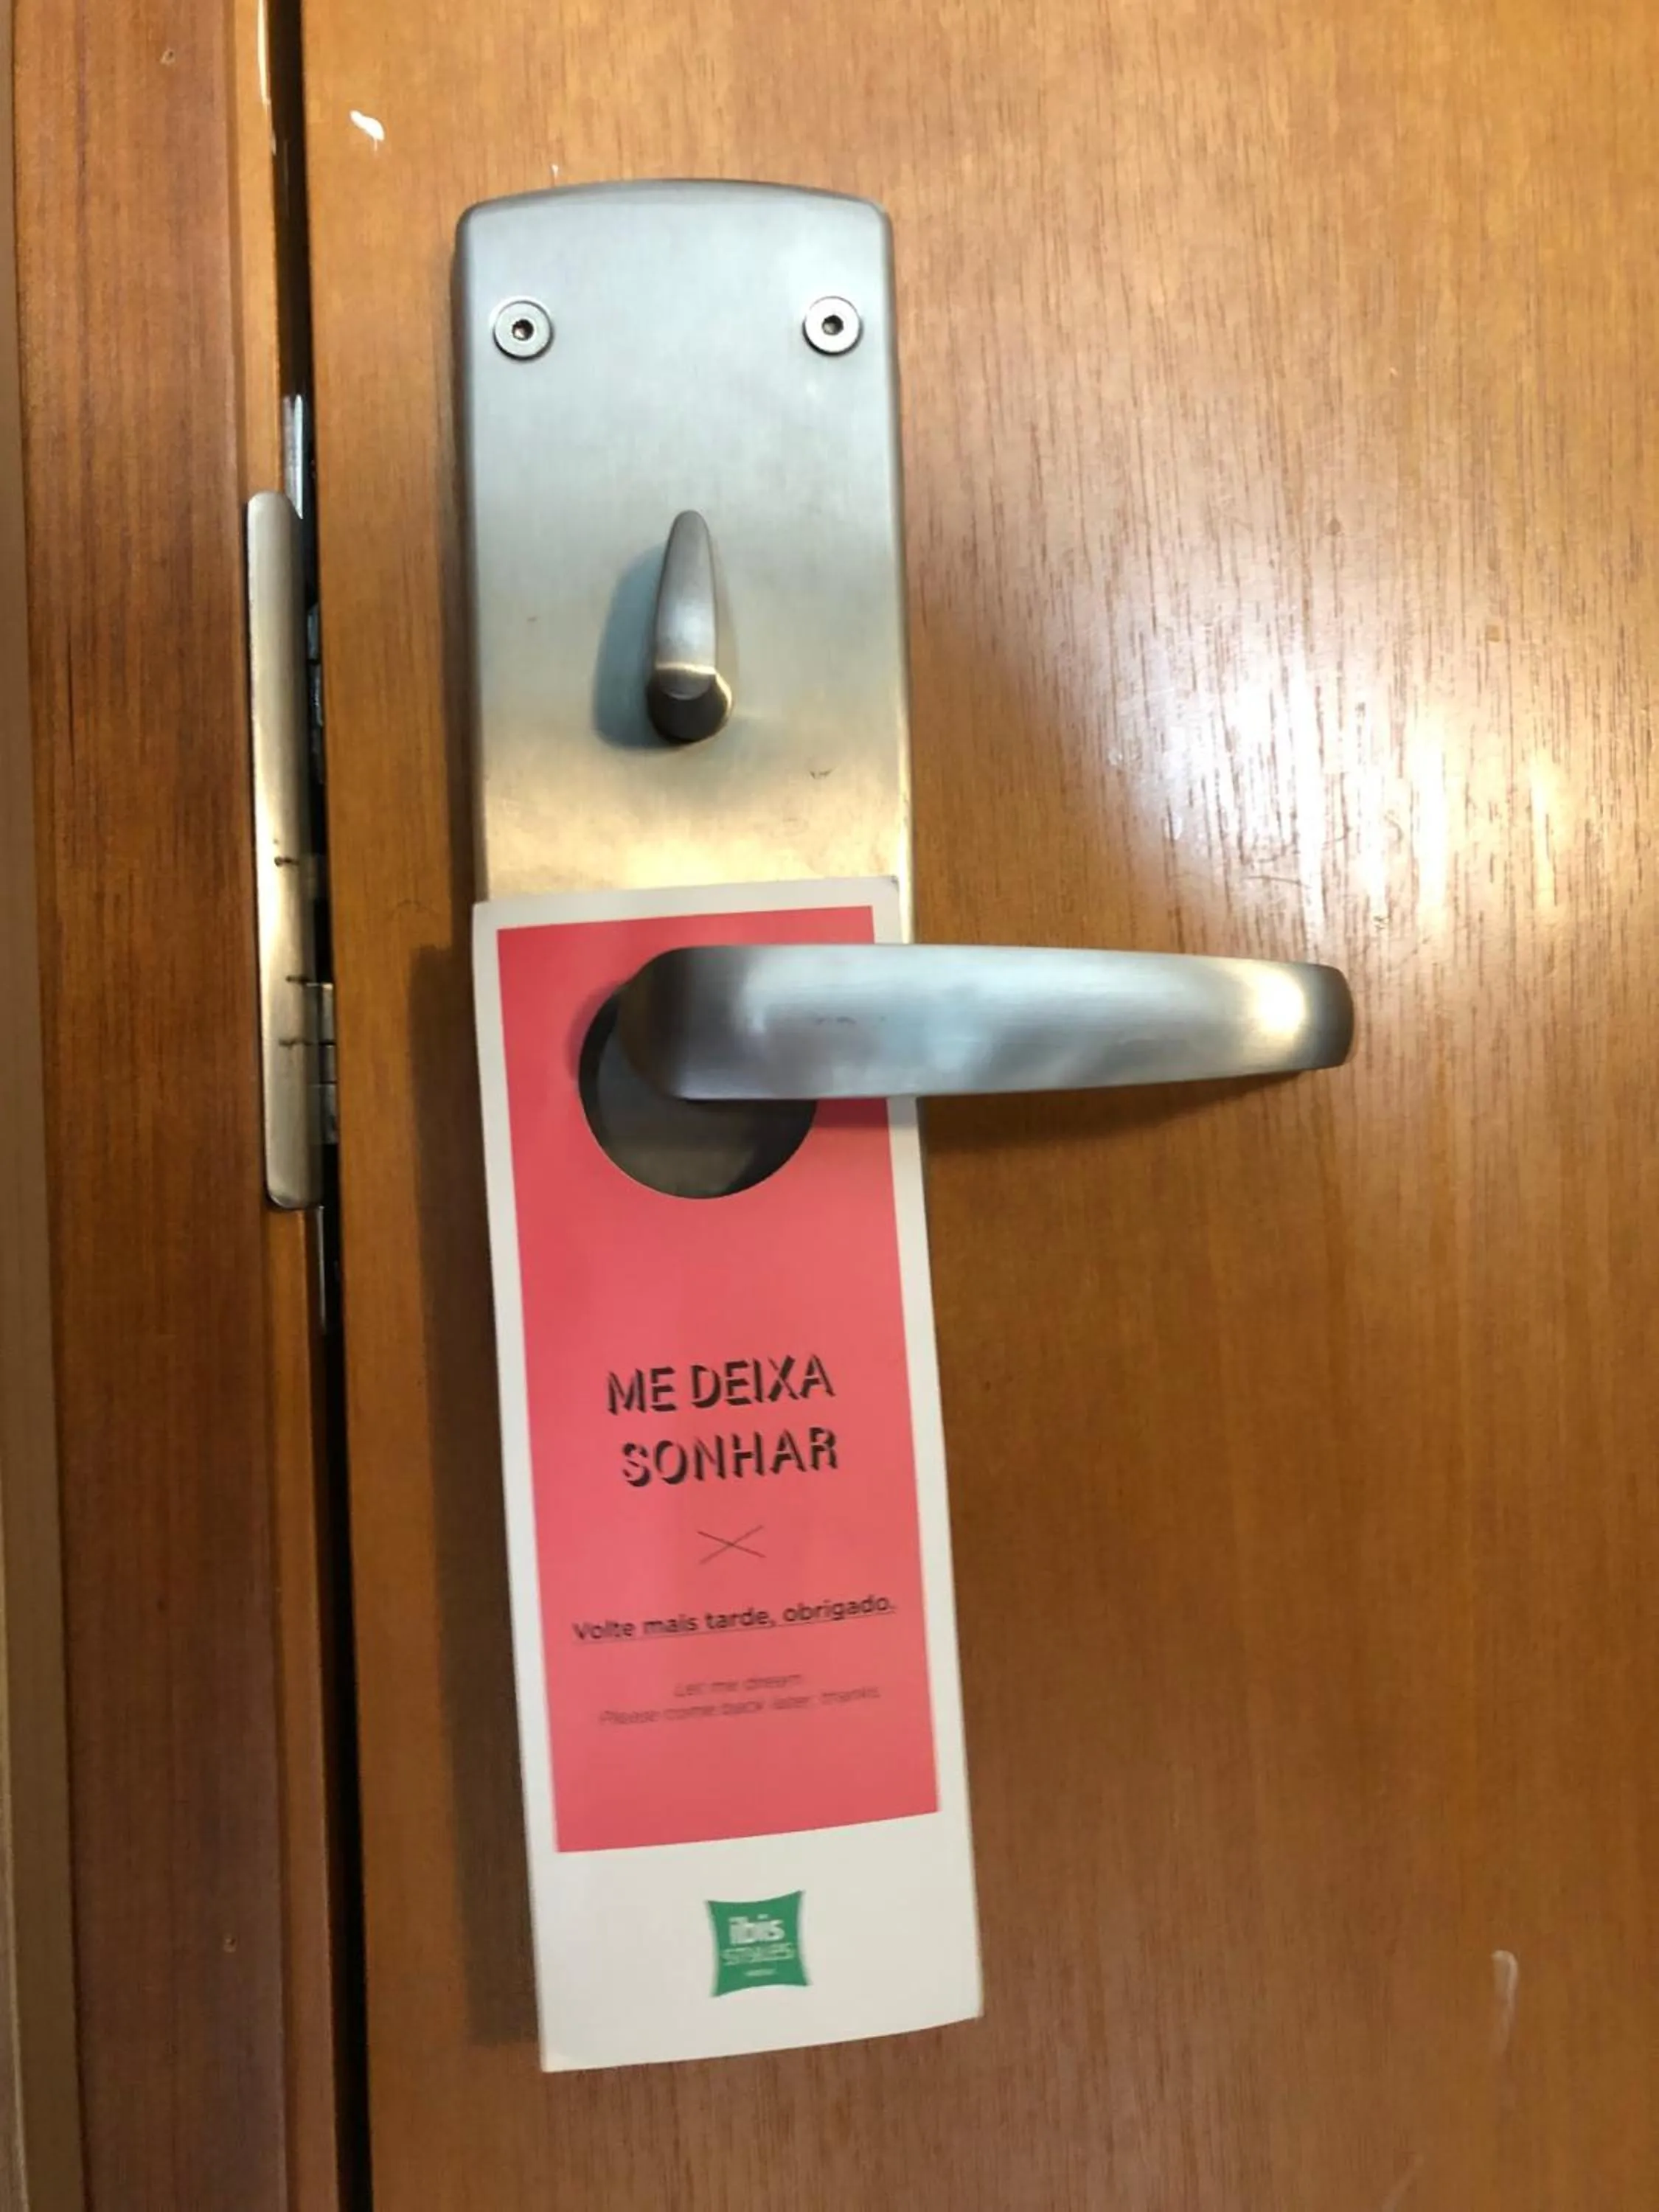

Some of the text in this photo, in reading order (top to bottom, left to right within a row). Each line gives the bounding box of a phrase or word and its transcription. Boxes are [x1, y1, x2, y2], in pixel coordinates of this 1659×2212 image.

[608, 1354, 836, 1415] ME DEIXA
[622, 1426, 838, 1487] SONHAR
[572, 1619, 635, 1640] Volte
[644, 1613, 698, 1634] mais
